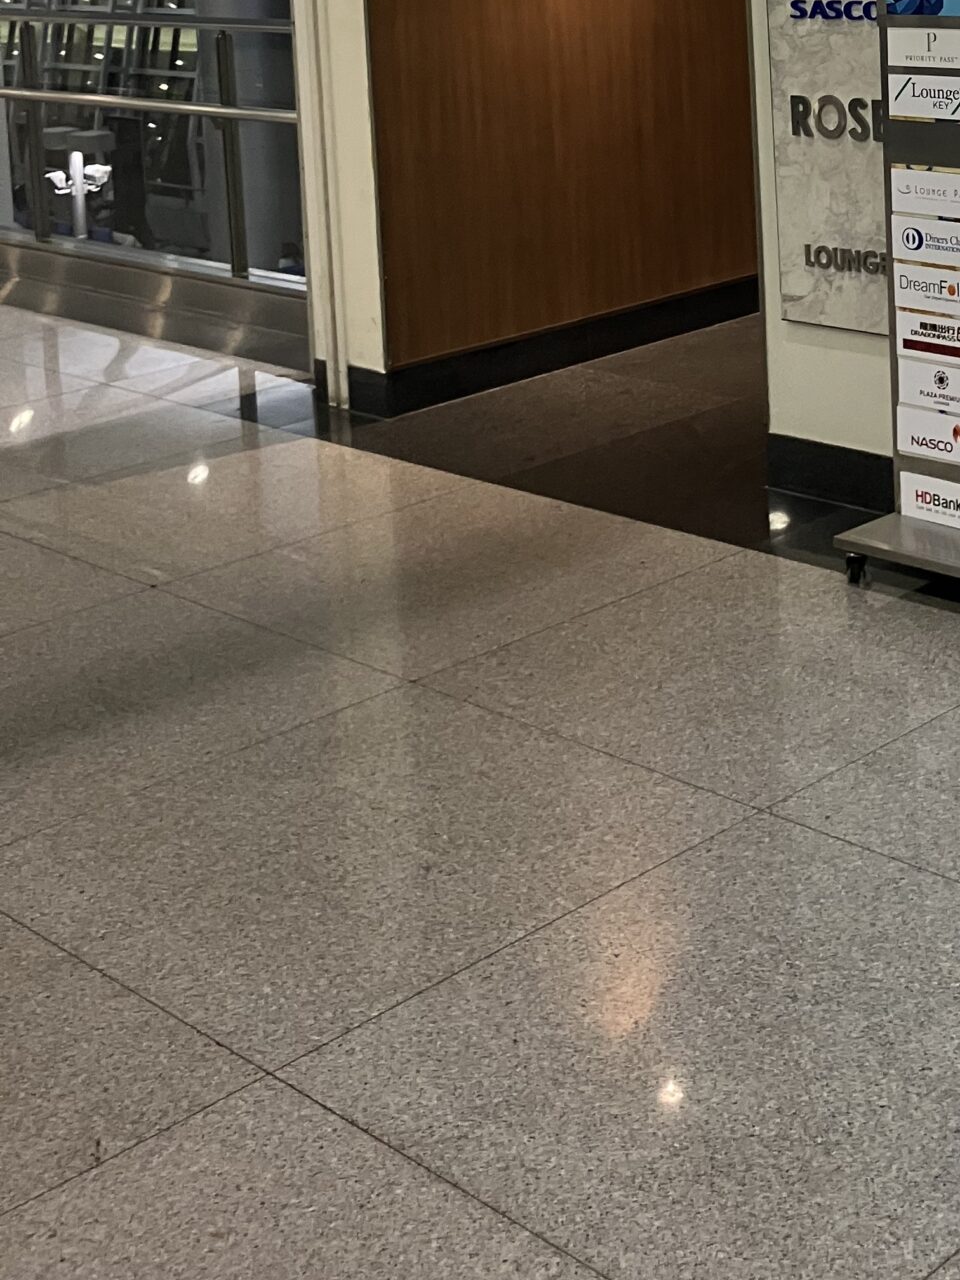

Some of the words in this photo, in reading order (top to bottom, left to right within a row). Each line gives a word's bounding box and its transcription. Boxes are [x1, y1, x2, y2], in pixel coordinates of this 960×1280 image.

[790, 0, 878, 21] SASCO
[904, 54, 936, 63] PRIORITY
[911, 82, 960, 104] Lounge
[932, 100, 950, 110] KEY
[925, 232, 949, 245] Diners
[910, 329, 956, 342] DRAGONPASS
[919, 389, 938, 398] PLAZA
[910, 435, 953, 453] NASCO
